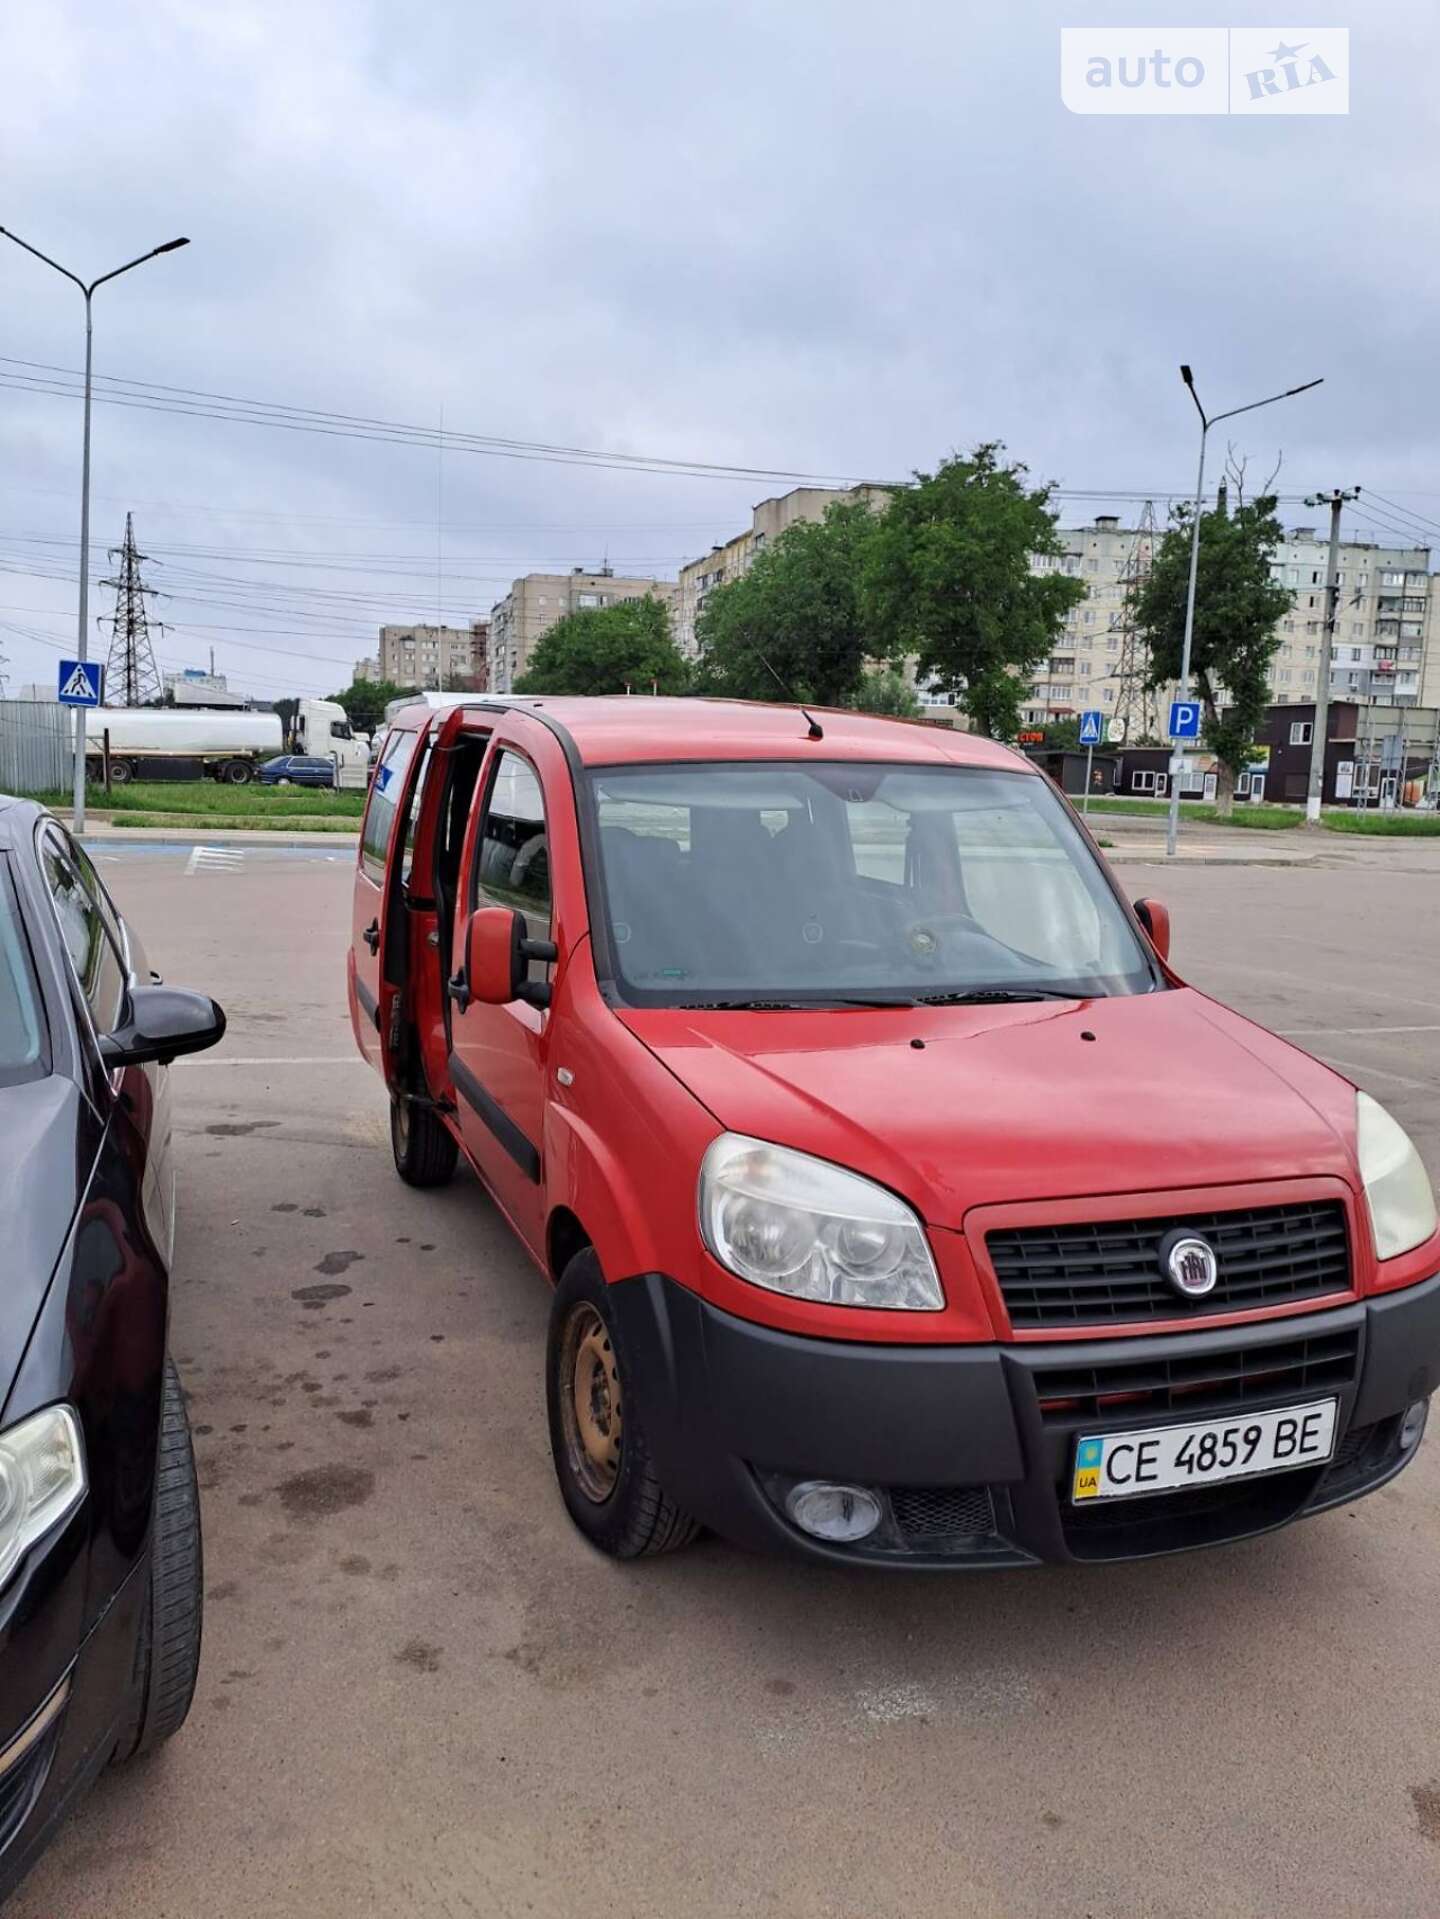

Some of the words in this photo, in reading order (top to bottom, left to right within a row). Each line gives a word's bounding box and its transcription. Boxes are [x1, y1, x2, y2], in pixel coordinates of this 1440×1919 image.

[1176, 706, 1194, 734] P
[1106, 1440, 1160, 1485] CE
[1174, 1425, 1262, 1474] 4859
[1273, 1413, 1322, 1459] BE
[1079, 1475, 1098, 1488] UA
